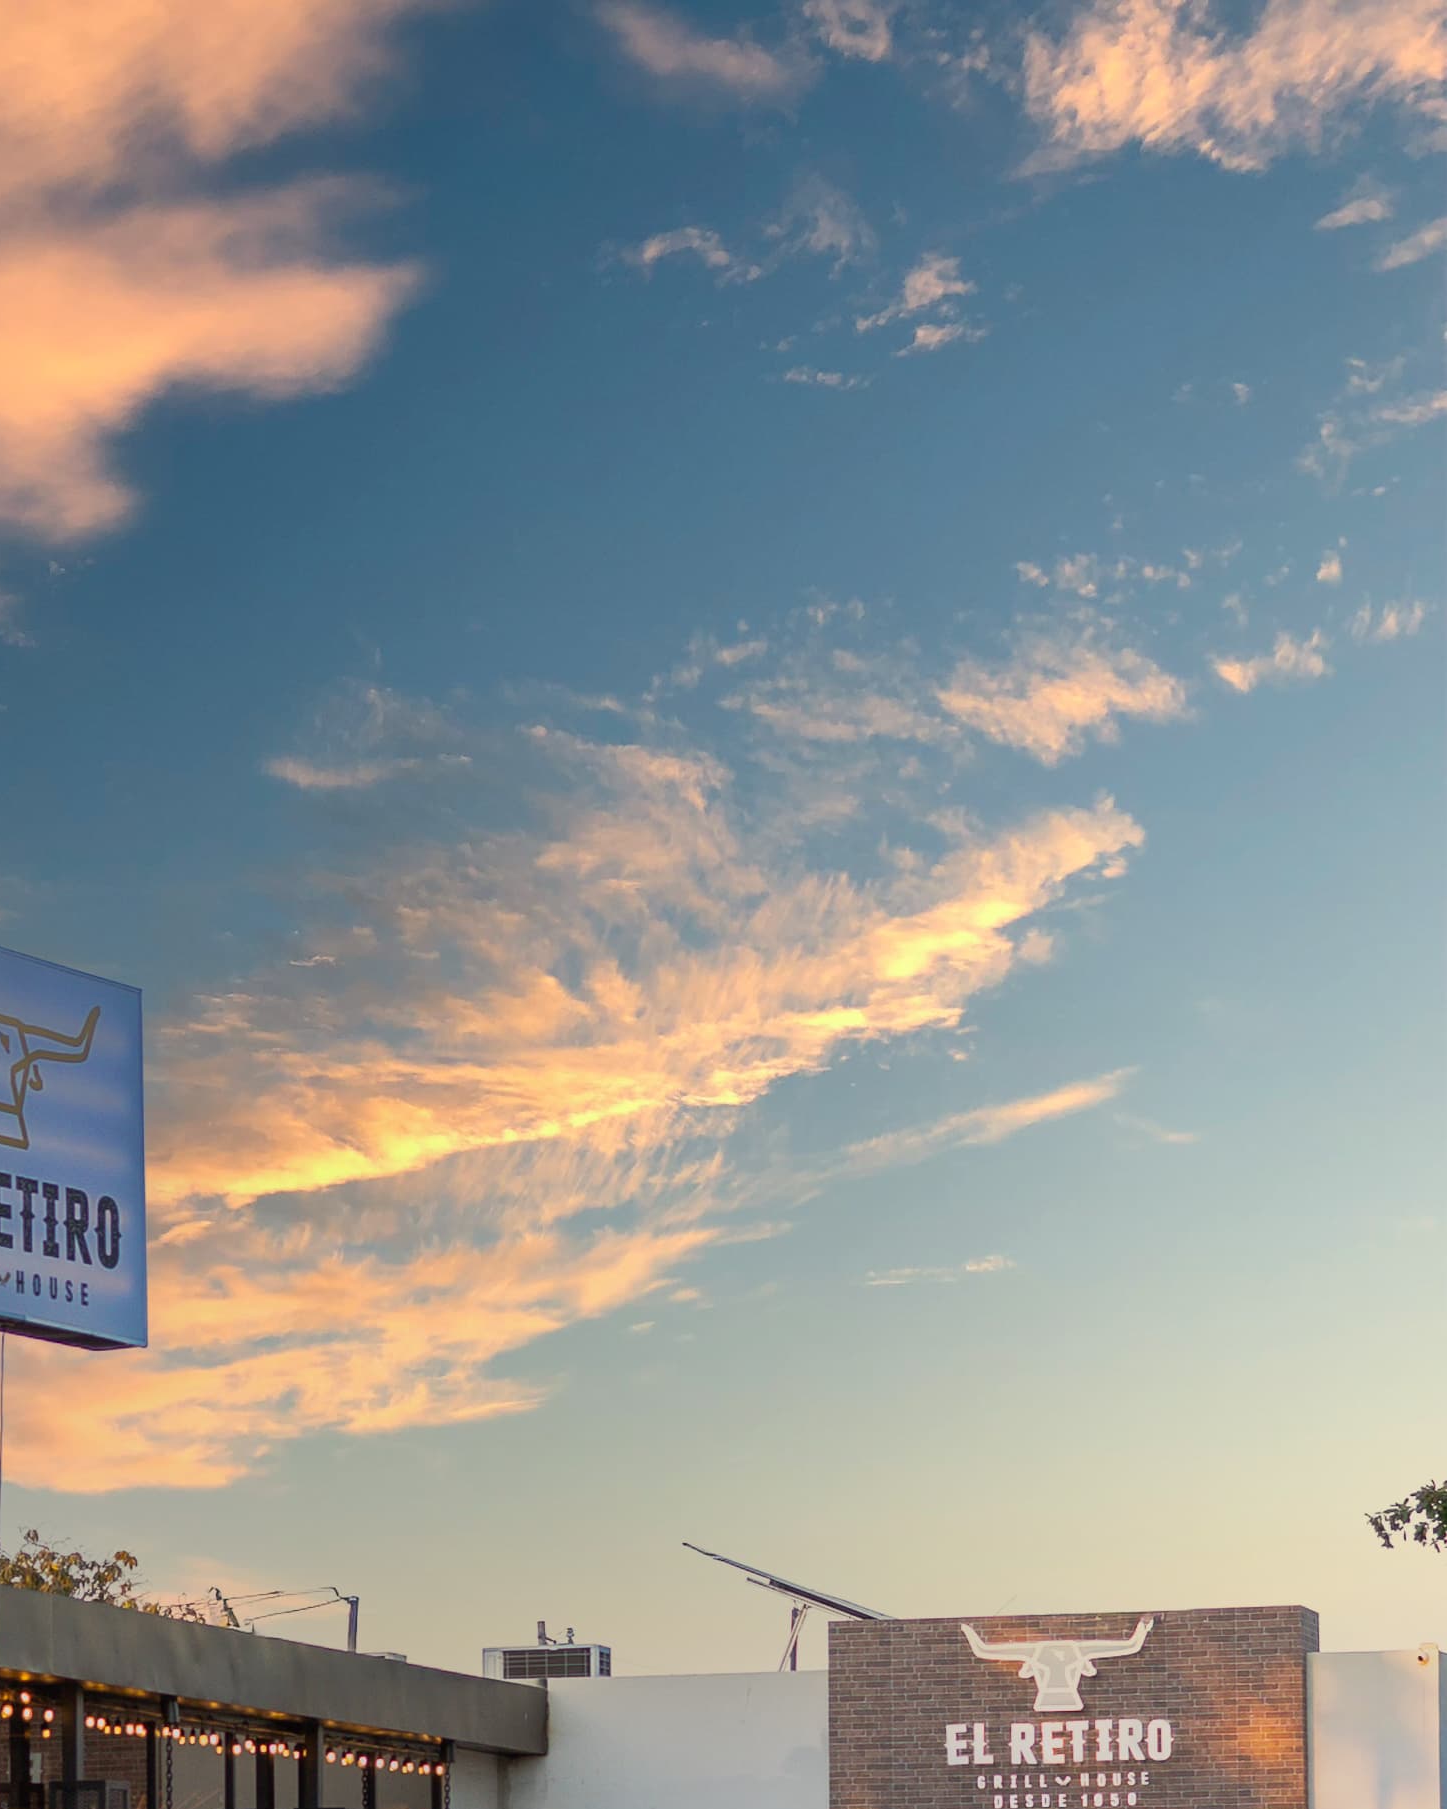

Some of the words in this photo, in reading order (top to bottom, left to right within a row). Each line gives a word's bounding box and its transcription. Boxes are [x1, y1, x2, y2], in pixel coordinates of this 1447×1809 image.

[16, 1269, 89, 1307] HOUSE
[944, 1722, 995, 1766] EL
[1009, 1718, 1175, 1766] RETIRO
[976, 1773, 1049, 1790] GRILL
[1079, 1771, 1150, 1788] HOUSE
[993, 1793, 1068, 1809] DESDE
